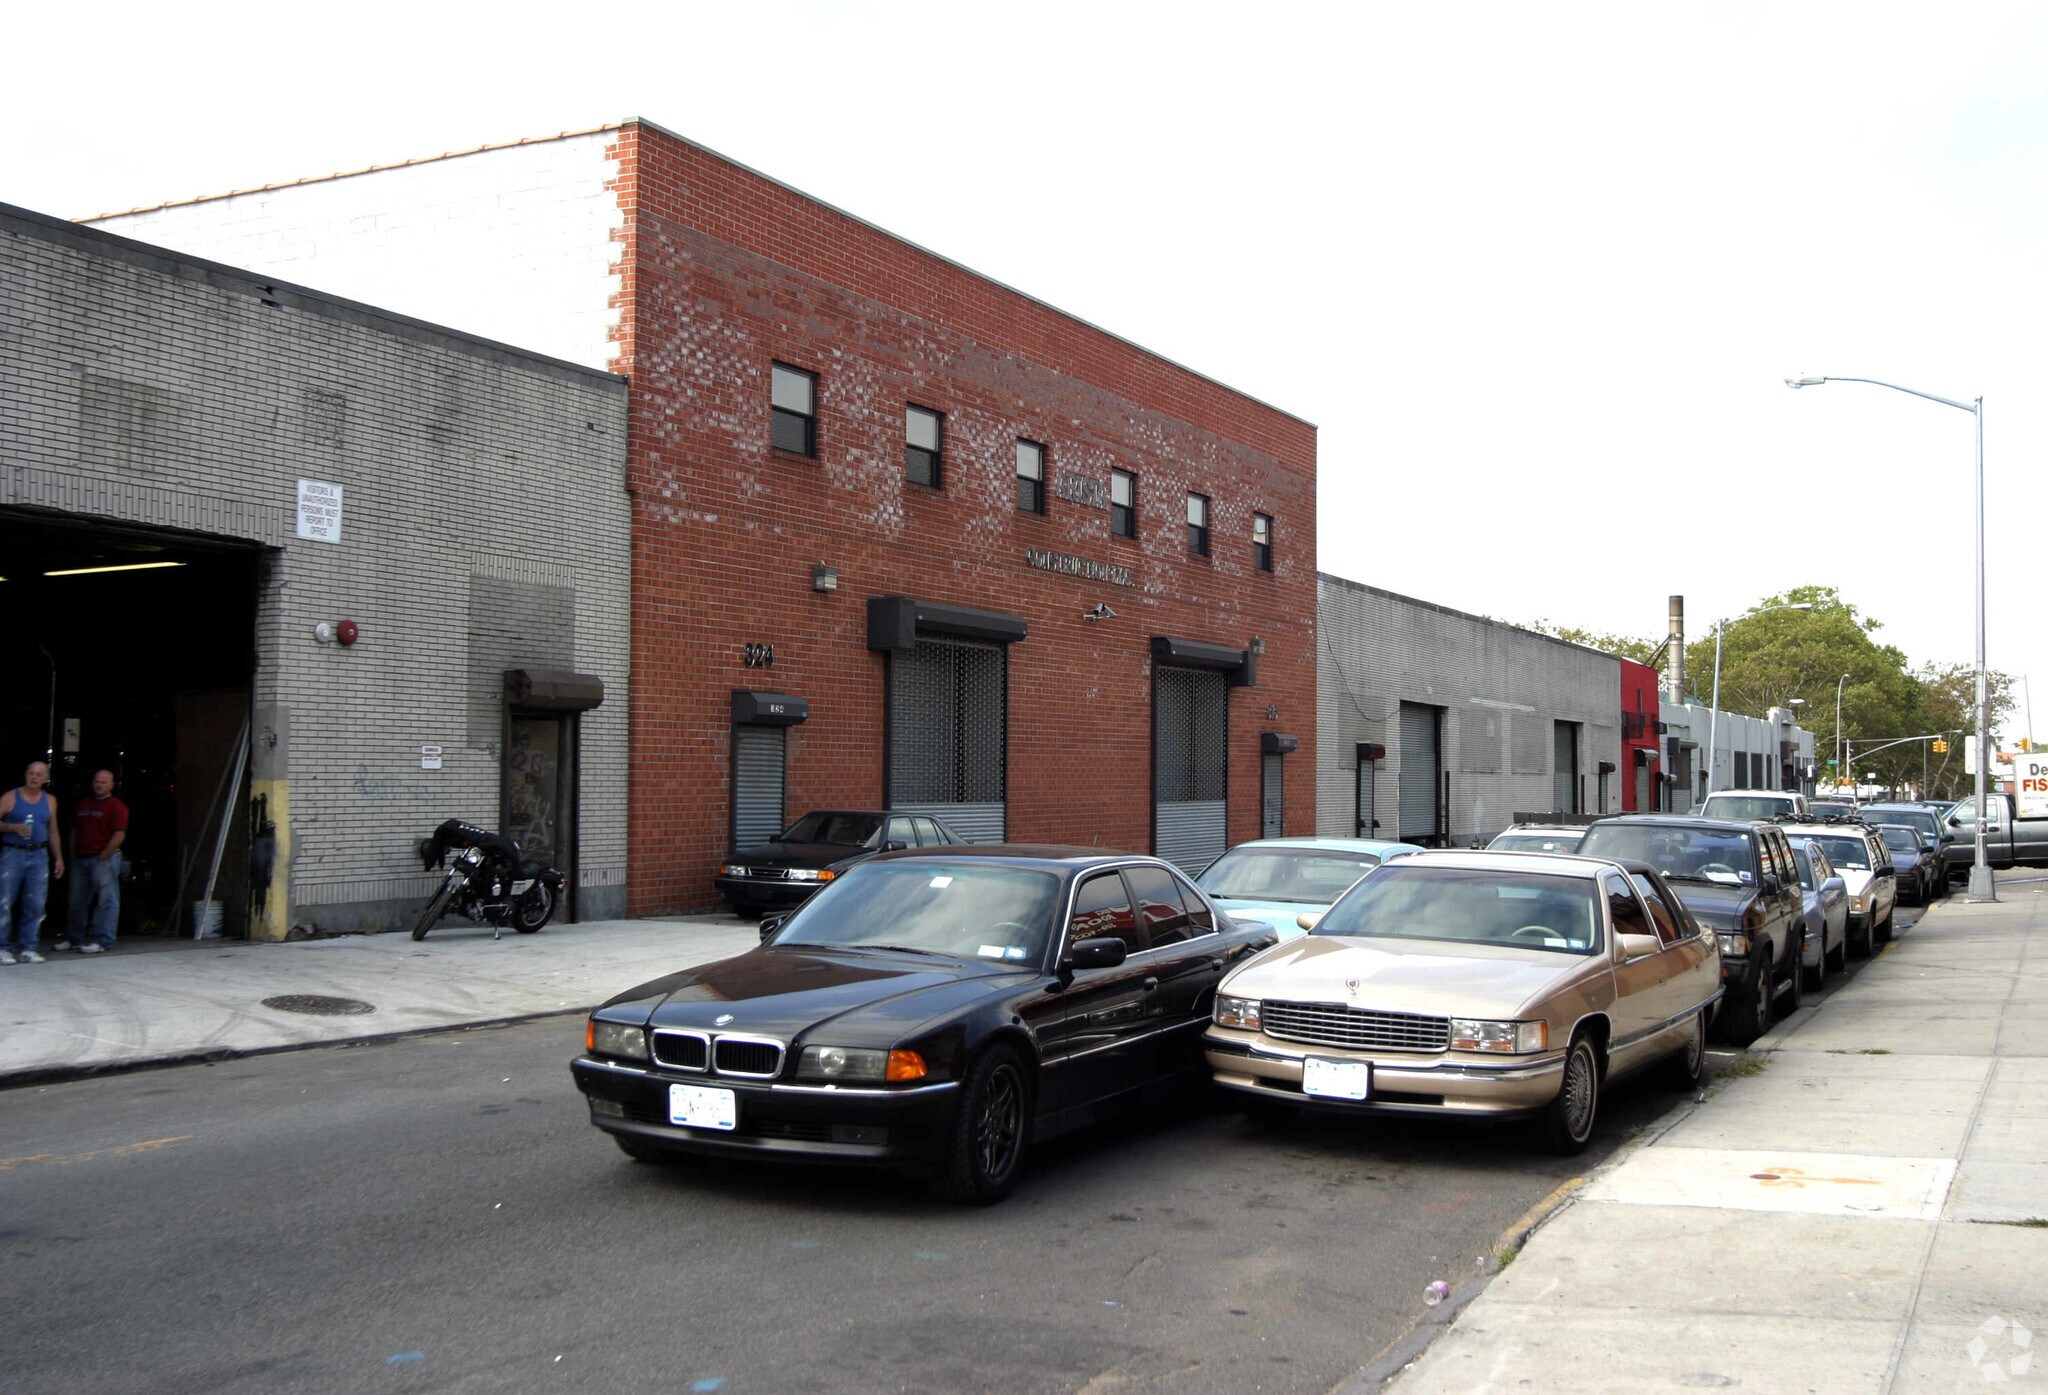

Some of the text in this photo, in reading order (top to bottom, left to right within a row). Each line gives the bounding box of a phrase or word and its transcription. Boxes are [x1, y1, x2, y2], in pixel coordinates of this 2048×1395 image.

[306, 484, 329, 496] VISITORS
[1056, 470, 1108, 510] ARISTA
[301, 494, 339, 508] UNAUTHORIZED
[301, 503, 339, 518] PERSONS MUST
[305, 514, 334, 528] REPORT TO
[310, 526, 328, 537] OFFICE
[1027, 548, 1108, 581] CONSTRUCTION
[745, 642, 774, 668] 324
